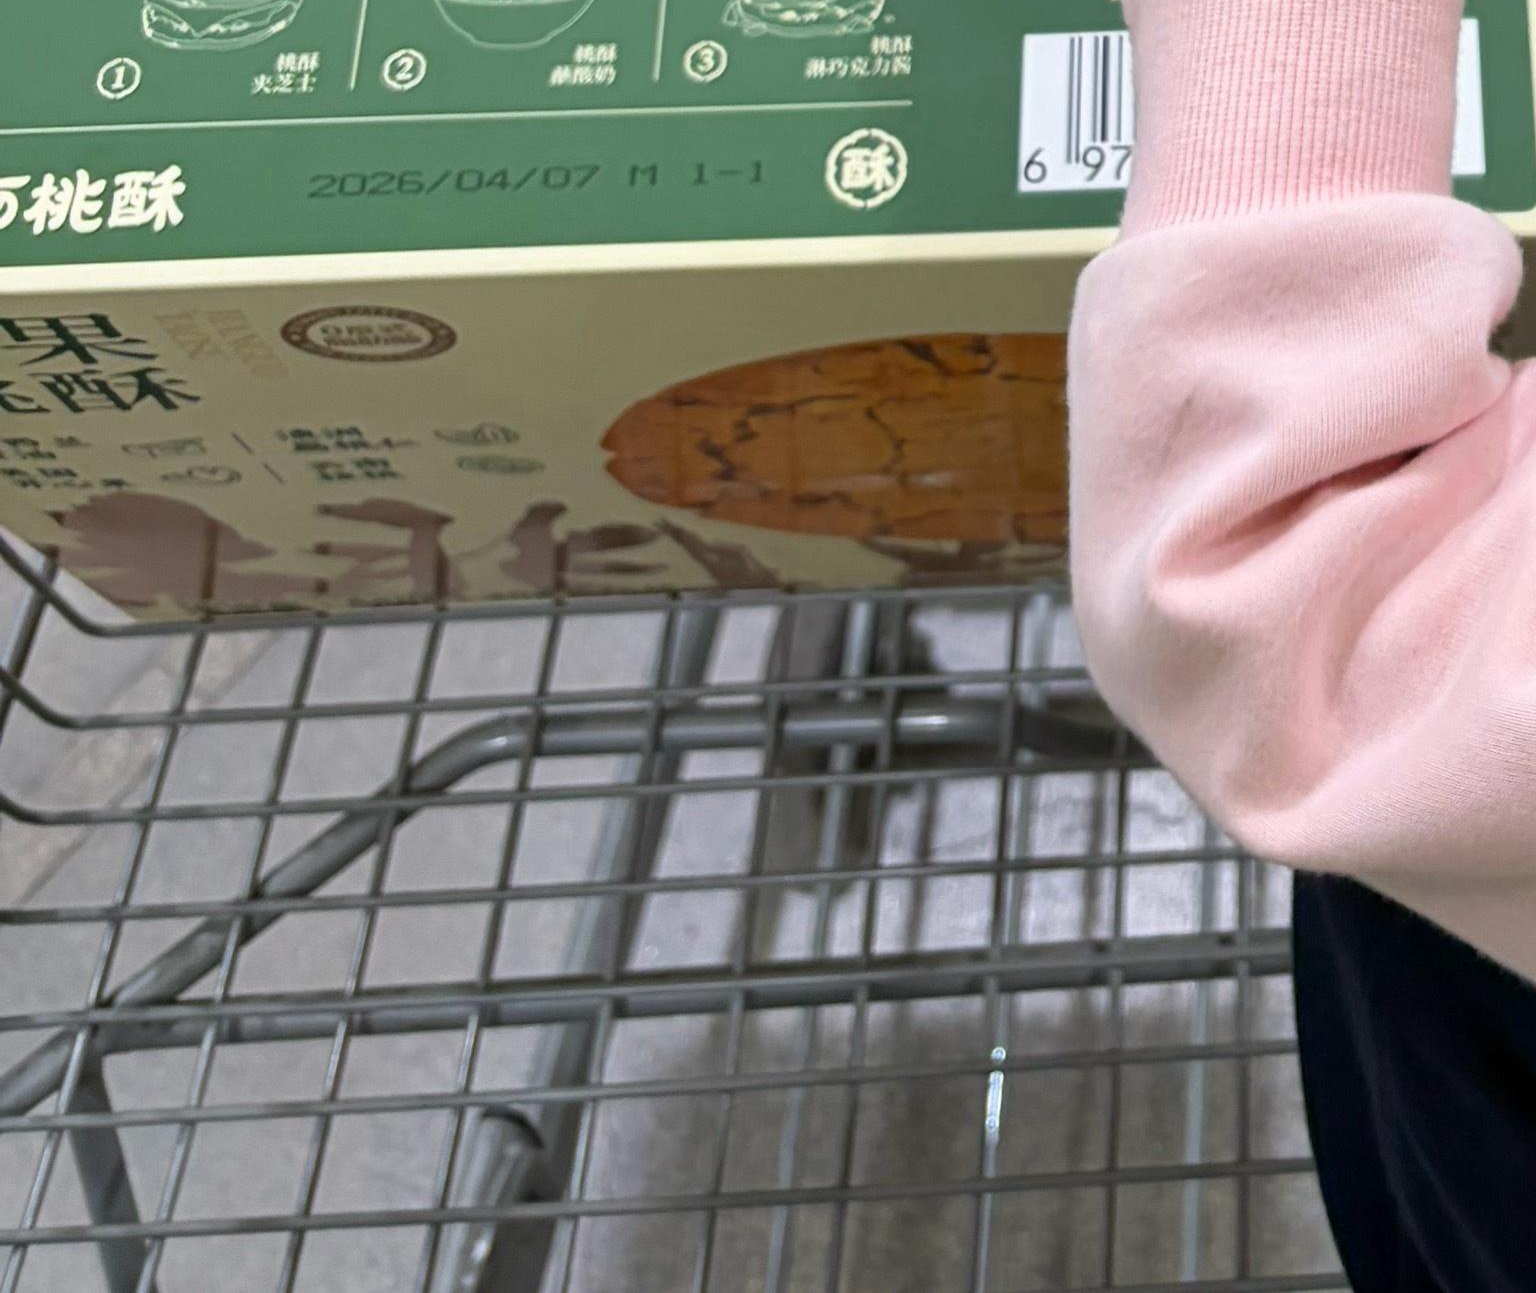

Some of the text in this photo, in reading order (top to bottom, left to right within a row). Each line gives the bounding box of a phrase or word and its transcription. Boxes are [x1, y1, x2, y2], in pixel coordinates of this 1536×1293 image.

[306, 164, 601, 199] 2026/04/07
[840, 146, 895, 191] 酥
[1023, 146, 1048, 184] 6
